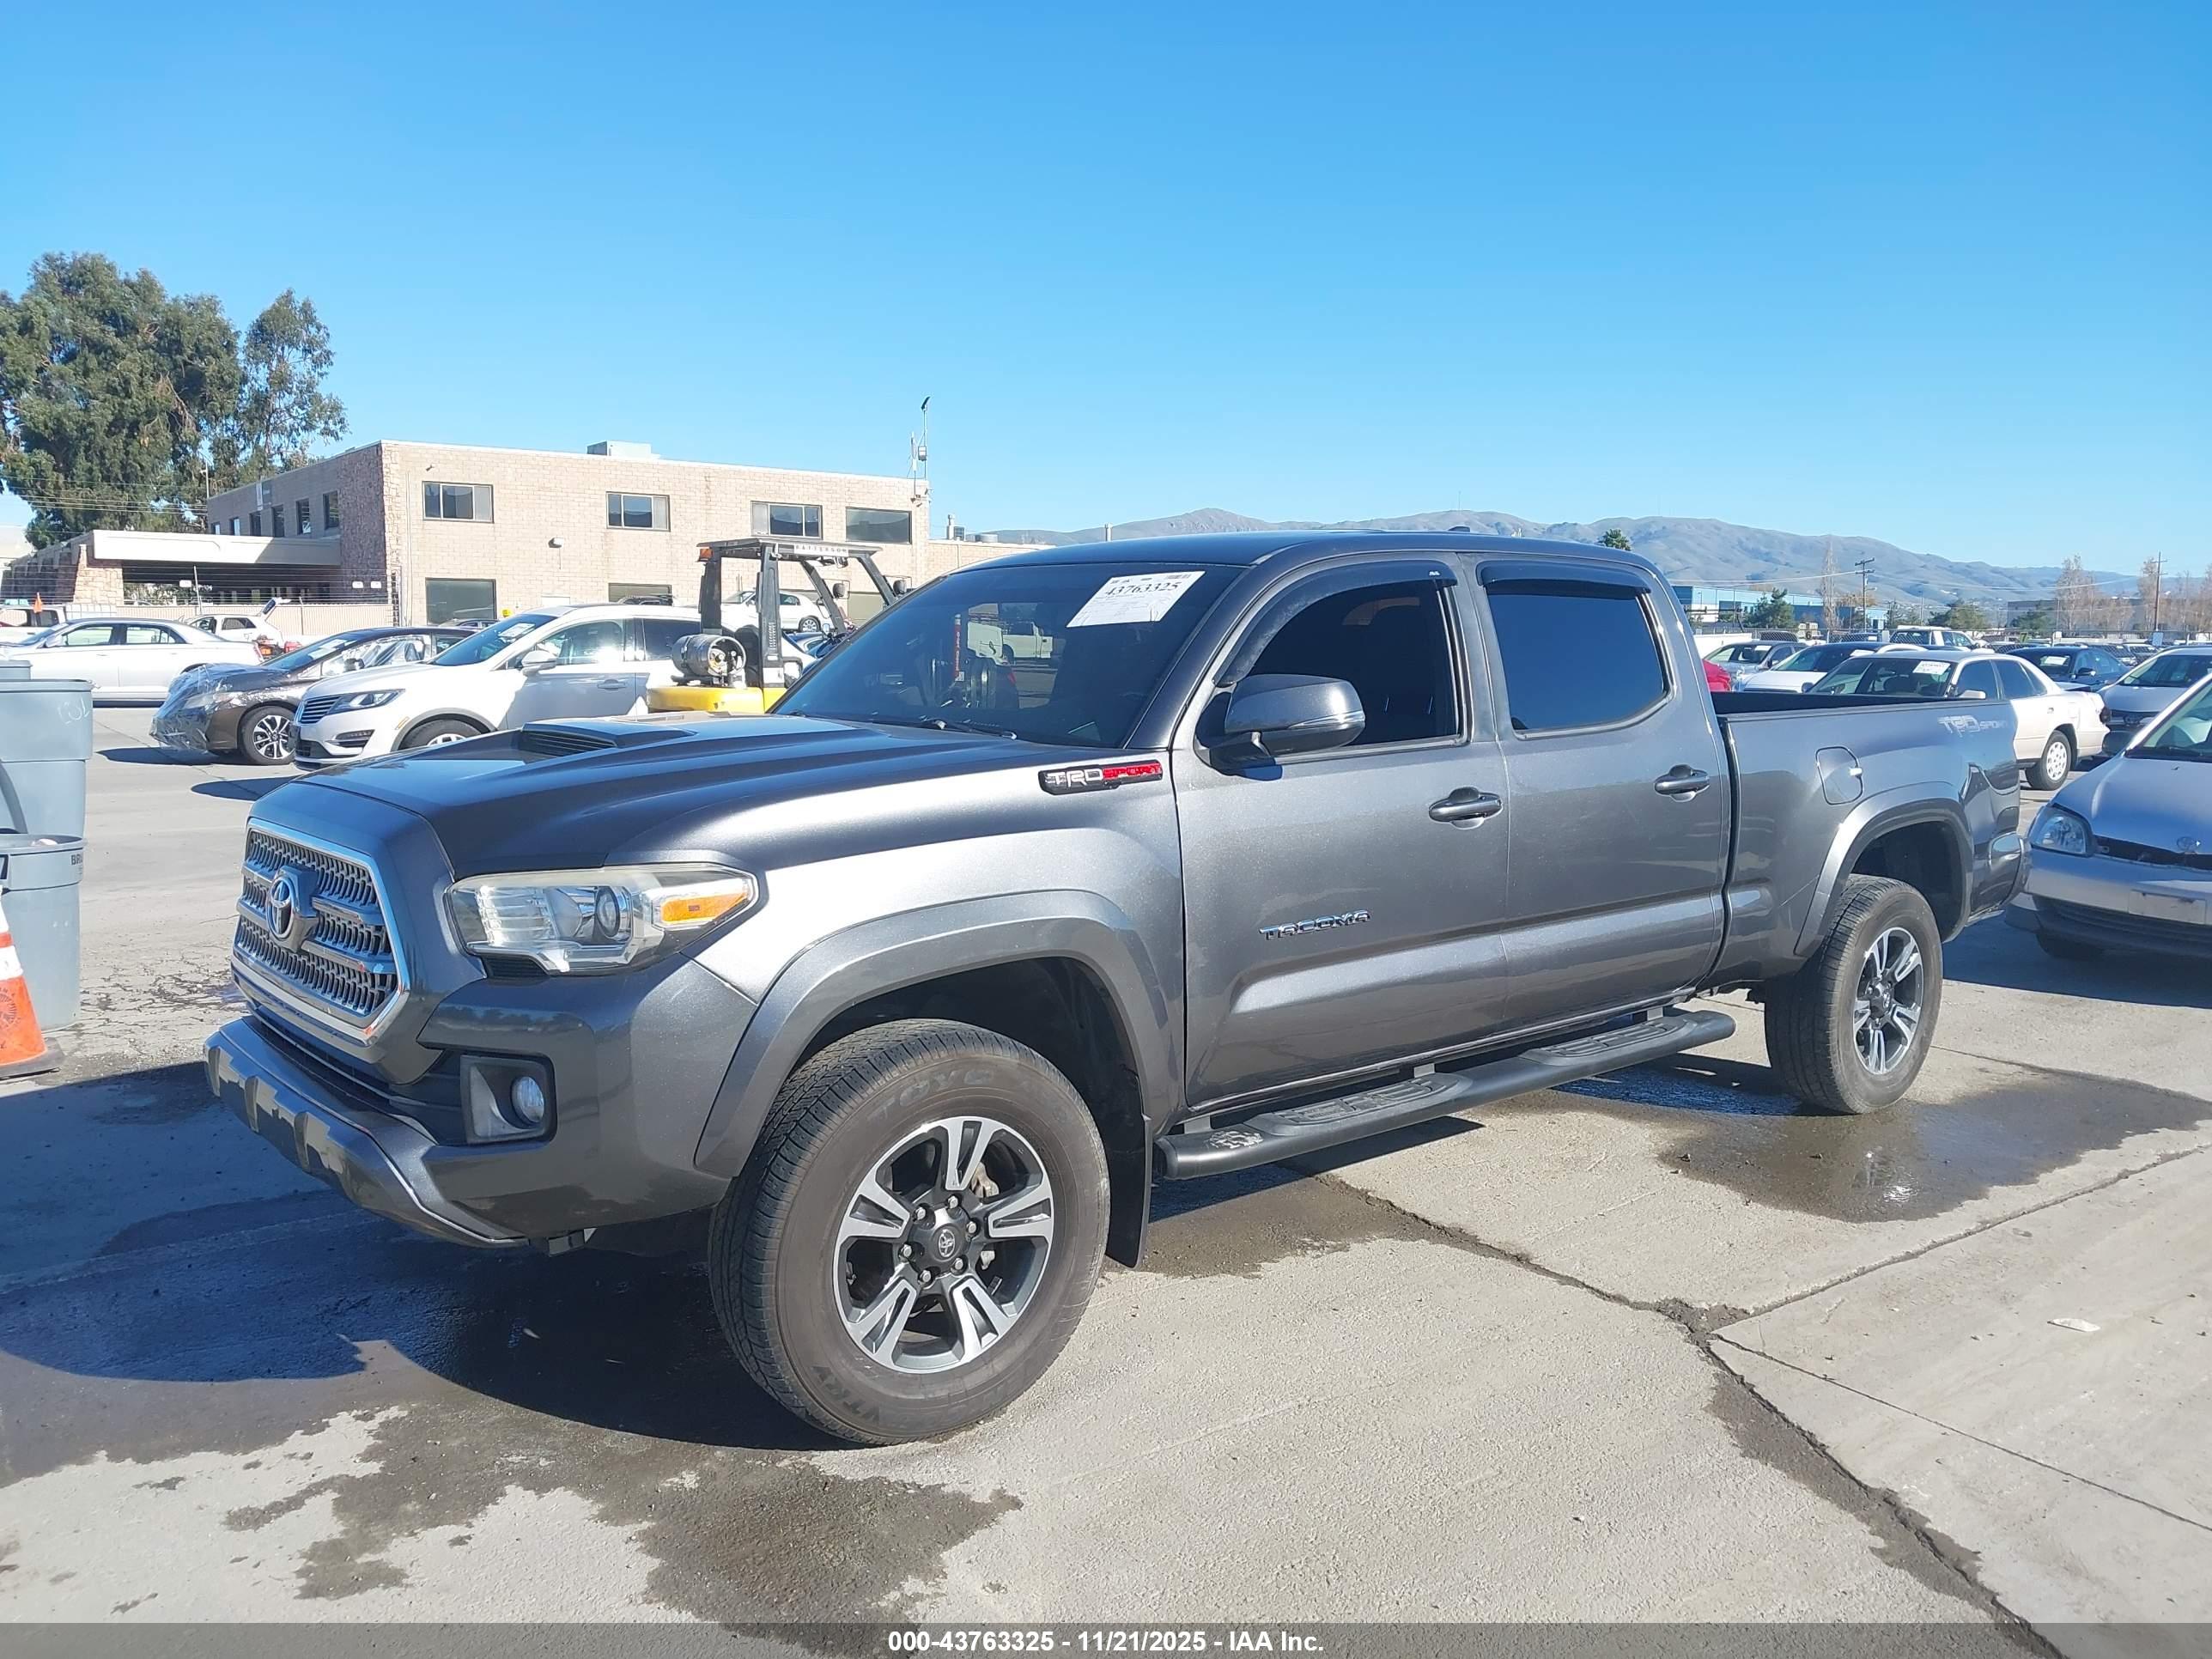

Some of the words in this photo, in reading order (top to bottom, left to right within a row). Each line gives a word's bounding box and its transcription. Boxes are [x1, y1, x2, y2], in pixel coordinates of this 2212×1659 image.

[1105, 581, 1182, 596] 43763325
[1937, 714, 1980, 738] TRD
[1045, 768, 1104, 788] TRD
[1258, 910, 1371, 940] TACOMA
